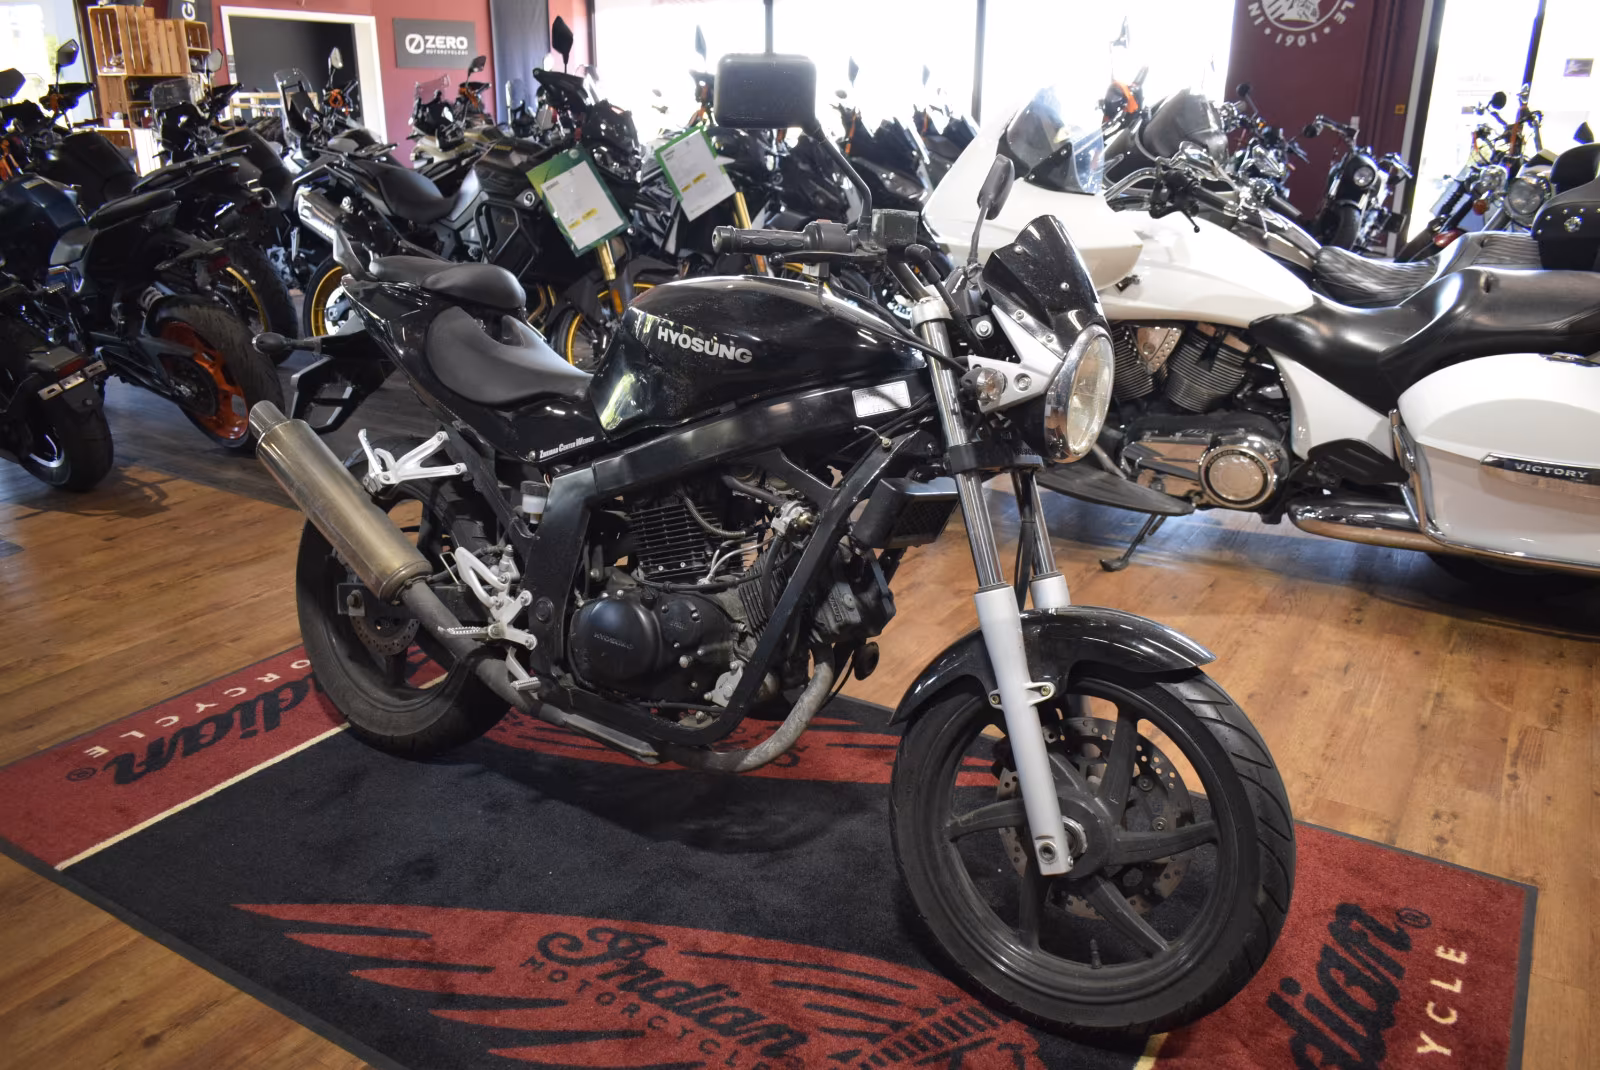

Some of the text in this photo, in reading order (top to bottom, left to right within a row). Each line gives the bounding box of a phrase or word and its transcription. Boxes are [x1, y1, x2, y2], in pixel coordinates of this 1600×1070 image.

[424, 35, 468, 49] ZERO
[1275, 32, 1317, 47] 1901
[657, 326, 753, 364] HYOSUNG
[1514, 462, 1588, 478] VICTORY
[84, 659, 310, 758] ORCYCLE
[104, 672, 325, 784] dian
[537, 927, 808, 1057] Indian
